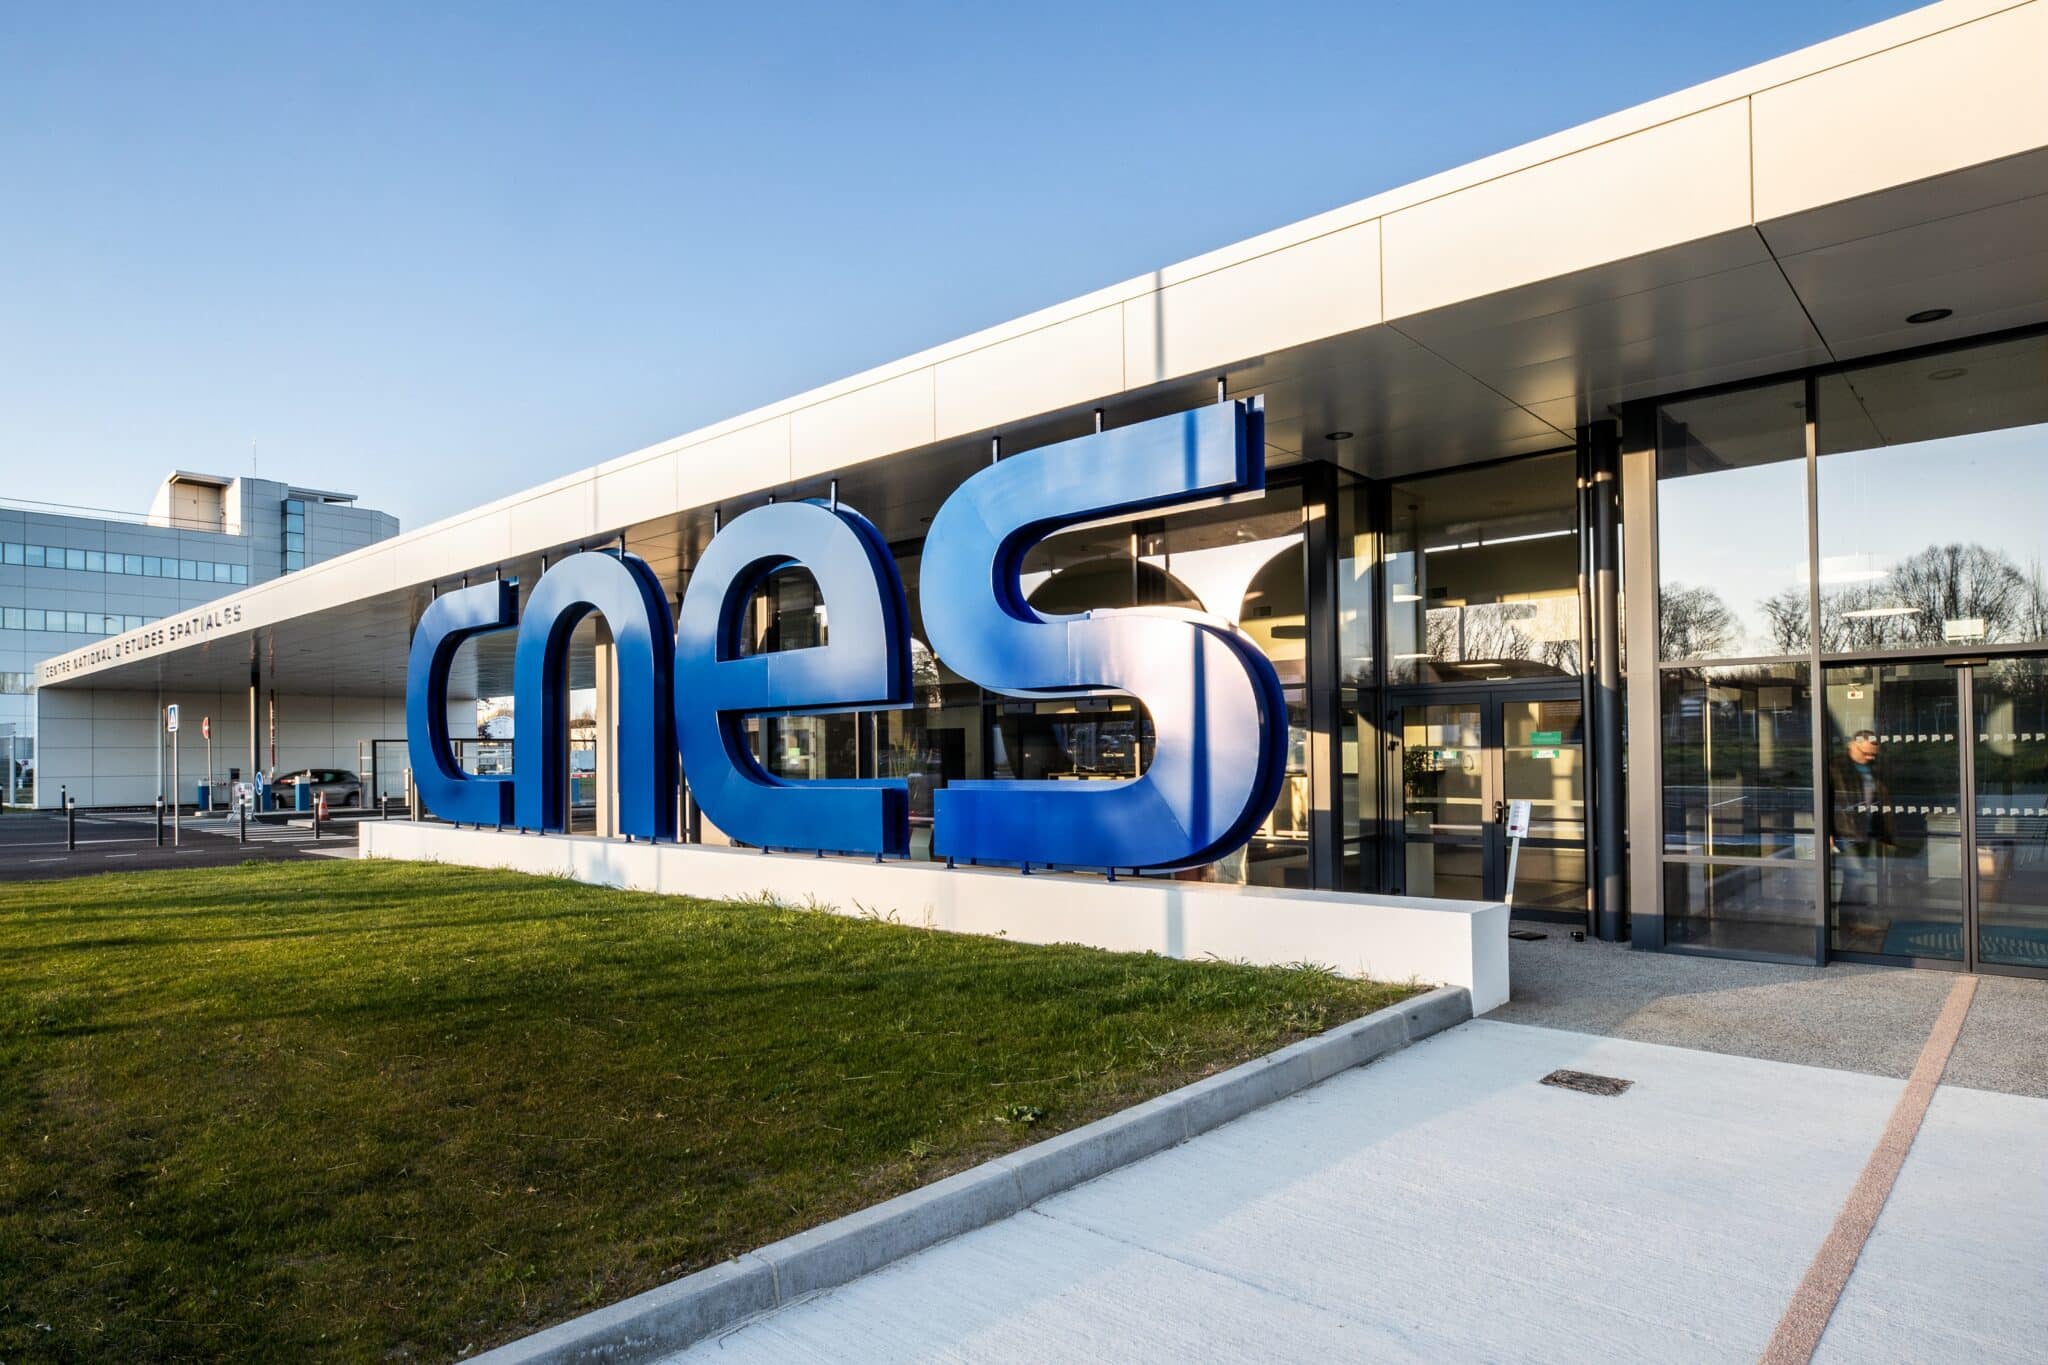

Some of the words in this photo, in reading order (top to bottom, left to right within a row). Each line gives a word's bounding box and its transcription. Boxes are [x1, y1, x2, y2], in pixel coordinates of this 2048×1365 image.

[45, 660, 71, 678] CENTRE
[74, 648, 112, 669] NATIONAL
[169, 604, 242, 641] SPATIALES
[408, 397, 1286, 871] cnes
